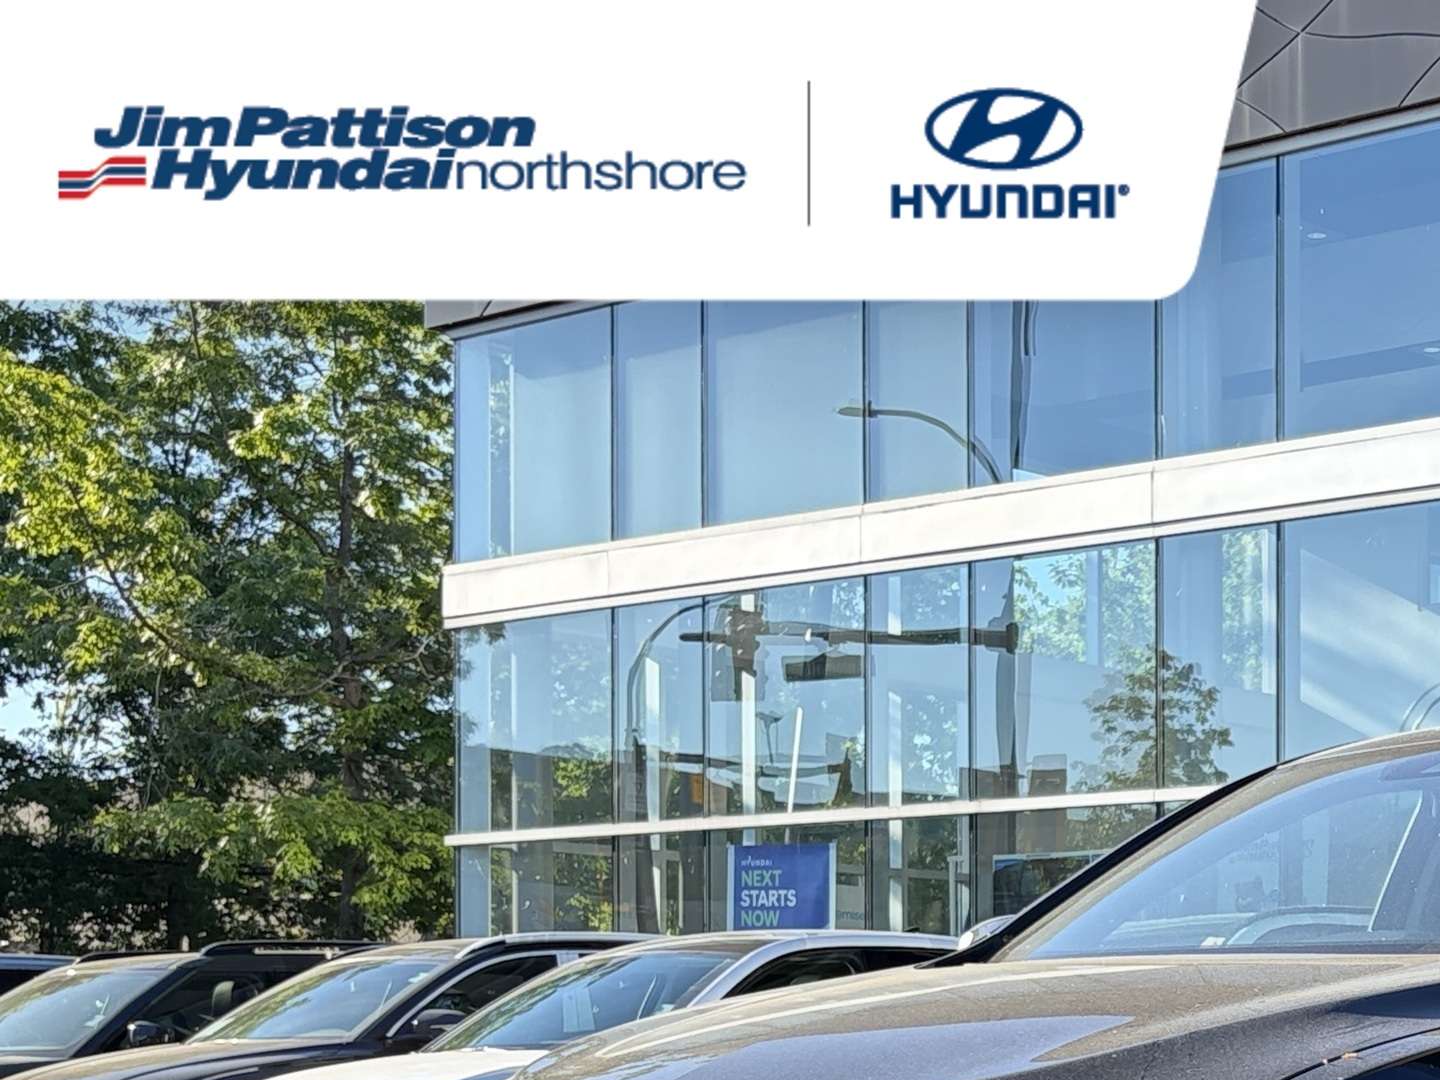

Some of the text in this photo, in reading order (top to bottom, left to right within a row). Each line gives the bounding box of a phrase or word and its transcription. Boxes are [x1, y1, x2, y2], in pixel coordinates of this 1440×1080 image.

[741, 870, 782, 888] NEXT
[740, 889, 797, 908] STARTS
[741, 910, 780, 928] NOW
